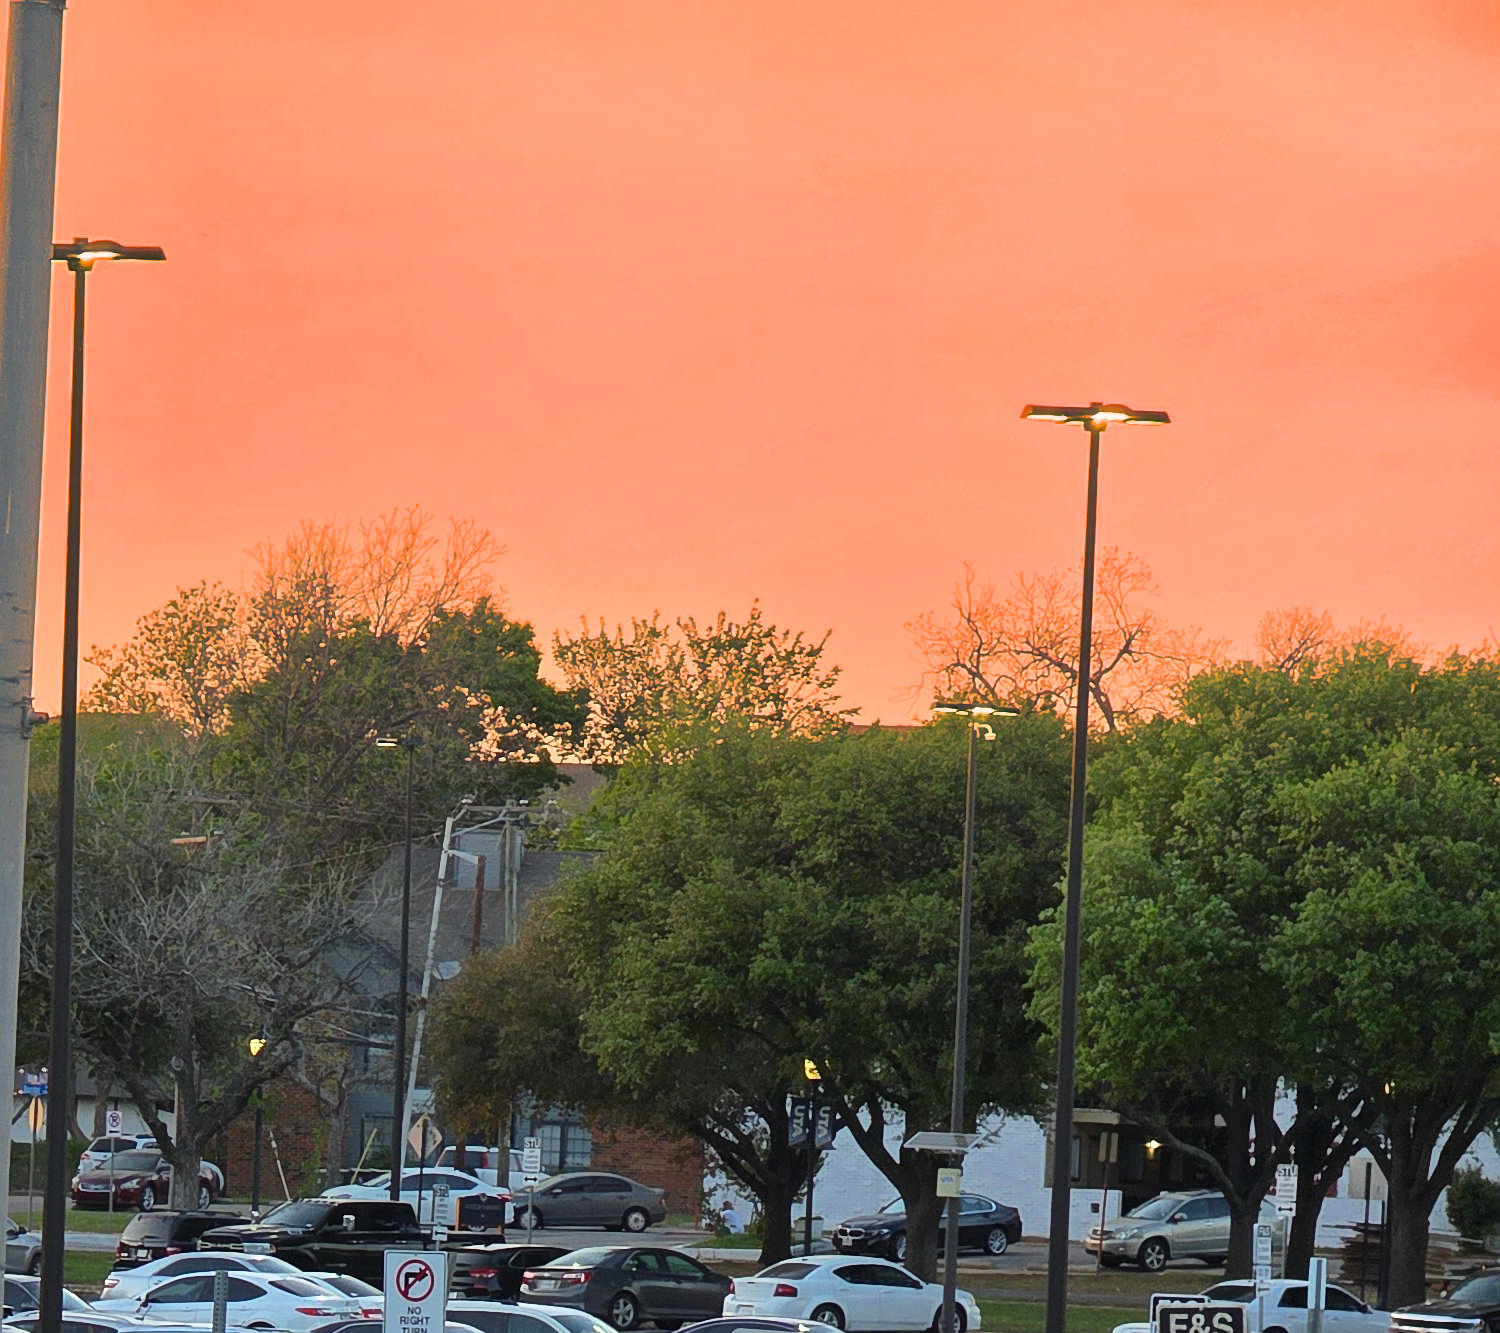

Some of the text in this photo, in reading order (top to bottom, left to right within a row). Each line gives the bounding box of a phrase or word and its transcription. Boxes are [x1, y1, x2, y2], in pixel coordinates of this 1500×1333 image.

[791, 1105, 806, 1138] UTA
[816, 1106, 831, 1138] UTA
[400, 1316, 431, 1326] RIGHT
[407, 1306, 422, 1315] NO
